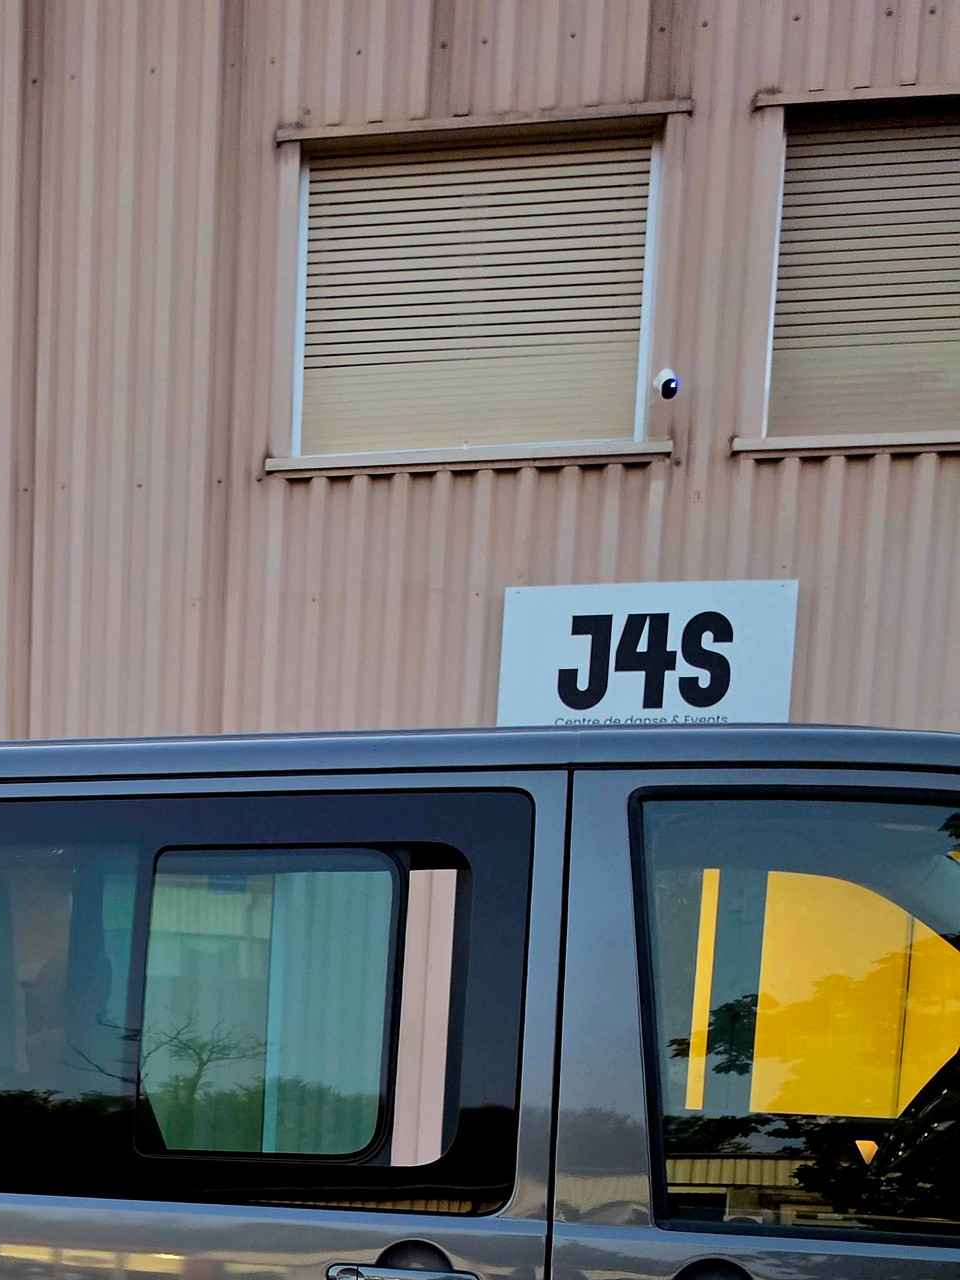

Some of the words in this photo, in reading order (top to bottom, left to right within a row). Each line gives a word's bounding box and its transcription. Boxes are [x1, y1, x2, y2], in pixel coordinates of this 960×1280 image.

[558, 611, 734, 710] J4S
[554, 717, 600, 726] Centre
[604, 716, 621, 725] de
[625, 715, 667, 725] danse
[684, 714, 729, 724] Events
